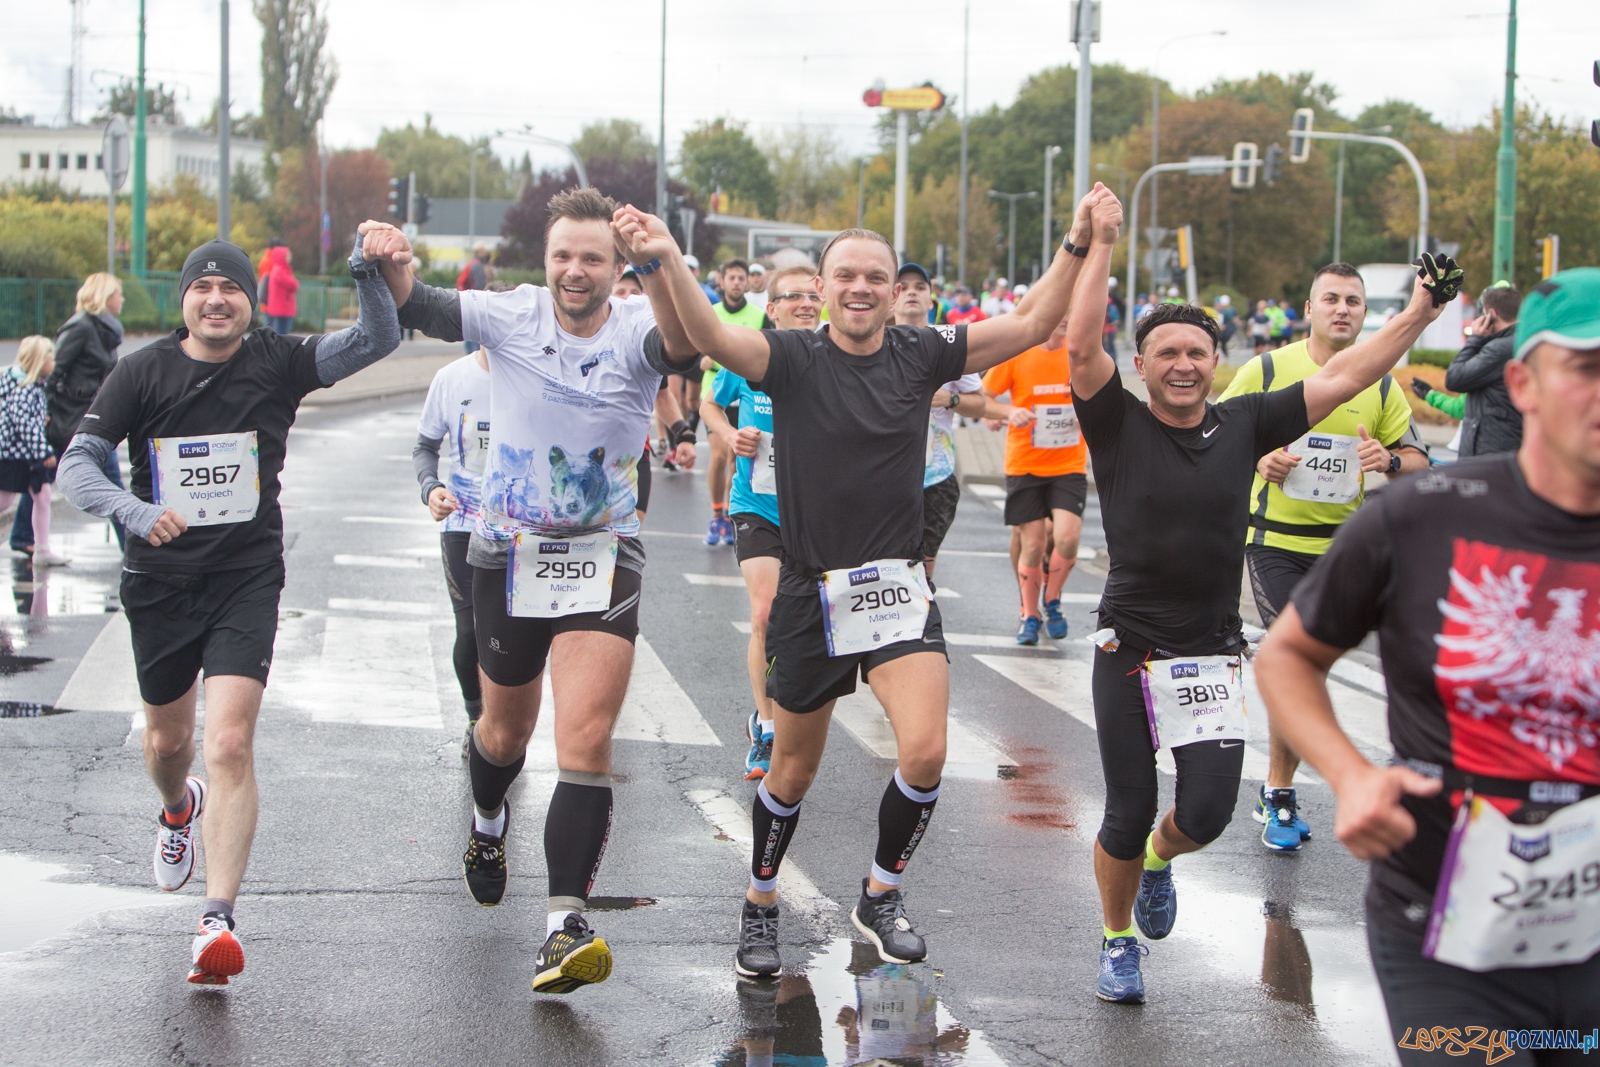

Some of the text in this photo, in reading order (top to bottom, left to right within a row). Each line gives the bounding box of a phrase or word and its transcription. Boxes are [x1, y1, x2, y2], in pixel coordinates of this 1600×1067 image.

[1045, 418, 1074, 429] 2964
[1305, 456, 1347, 473] 4451
[180, 464, 241, 487] 2967
[189, 489, 233, 500] Wojciech
[536, 561, 597, 579] 2950
[550, 584, 581, 592] Michał
[851, 587, 912, 612] 2900
[869, 611, 900, 623] Maciej
[1177, 684, 1229, 706] 3819
[1192, 706, 1223, 717] Robert
[1492, 862, 1600, 911] 2249
